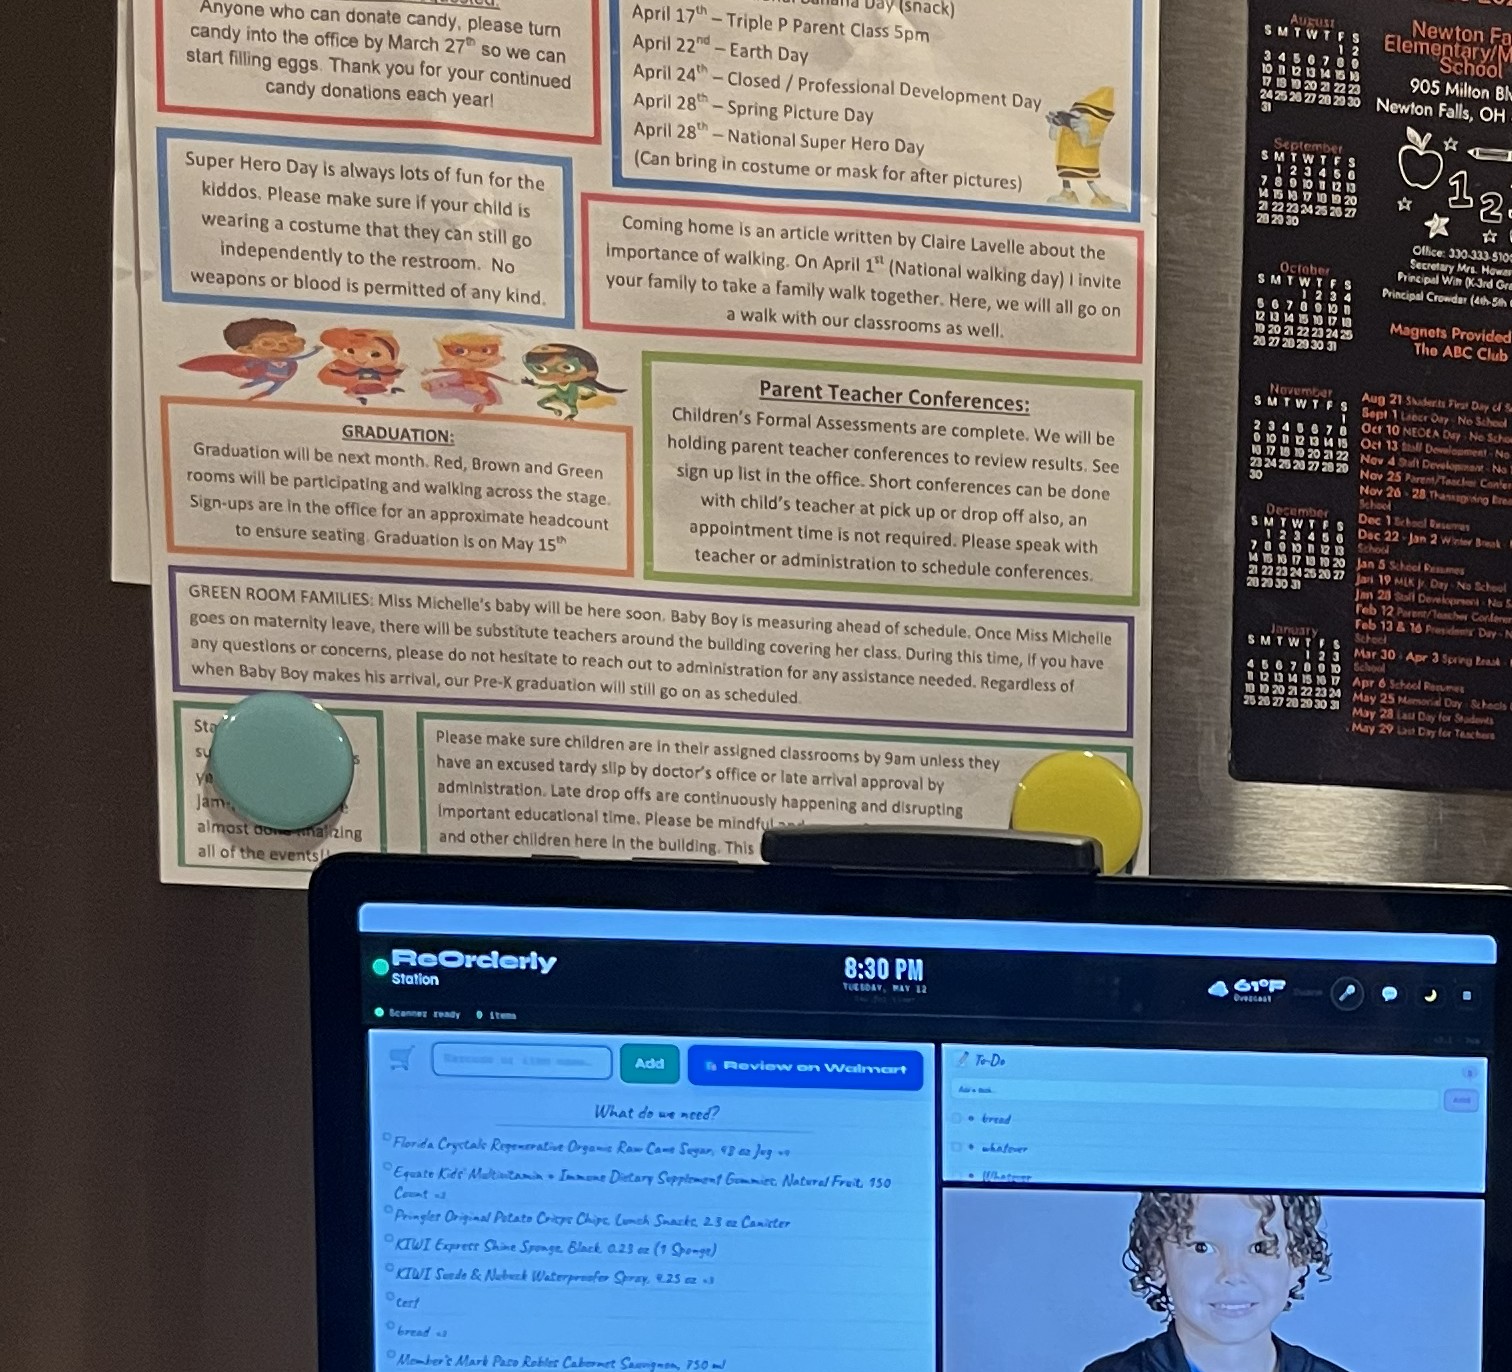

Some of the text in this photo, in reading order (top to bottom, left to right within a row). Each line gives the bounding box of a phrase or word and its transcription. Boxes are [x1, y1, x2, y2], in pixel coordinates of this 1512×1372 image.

[1412, 19, 1484, 44] Newton
[1439, 56, 1503, 79] School
[1410, 77, 1440, 96] 905
[1445, 81, 1490, 100] Milton
[1376, 97, 1433, 117] Newton
[1438, 103, 1474, 123] Falls,
[1479, 107, 1506, 123] OH
[184, 150, 545, 192] Super Hero Day is always lots of fun for the
[634, 148, 1023, 194] (Can bring in costume or mask for after pictures)
[1448, 170, 1474, 209] 1
[1480, 191, 1503, 224] 2
[1389, 322, 1448, 340] Magnets
[1451, 326, 1512, 344] Provided
[1414, 342, 1509, 362] The ABC Club
[760, 380, 1031, 413] Parent Teacher Conferences:
[342, 424, 455, 443] GRADUATION:
[436, 729, 1001, 773] Please make sure children are in their assigned classrooms by 9am unless they
[391, 949, 558, 975] ReOrderly
[844, 956, 924, 982] 8:30 PM
[391, 973, 440, 986] Station
[634, 1057, 665, 1071] Add
[723, 1060, 907, 1076] Review on Walmart
[594, 1103, 721, 1121] What do we need?
[397, 1326, 432, 1338] bread
